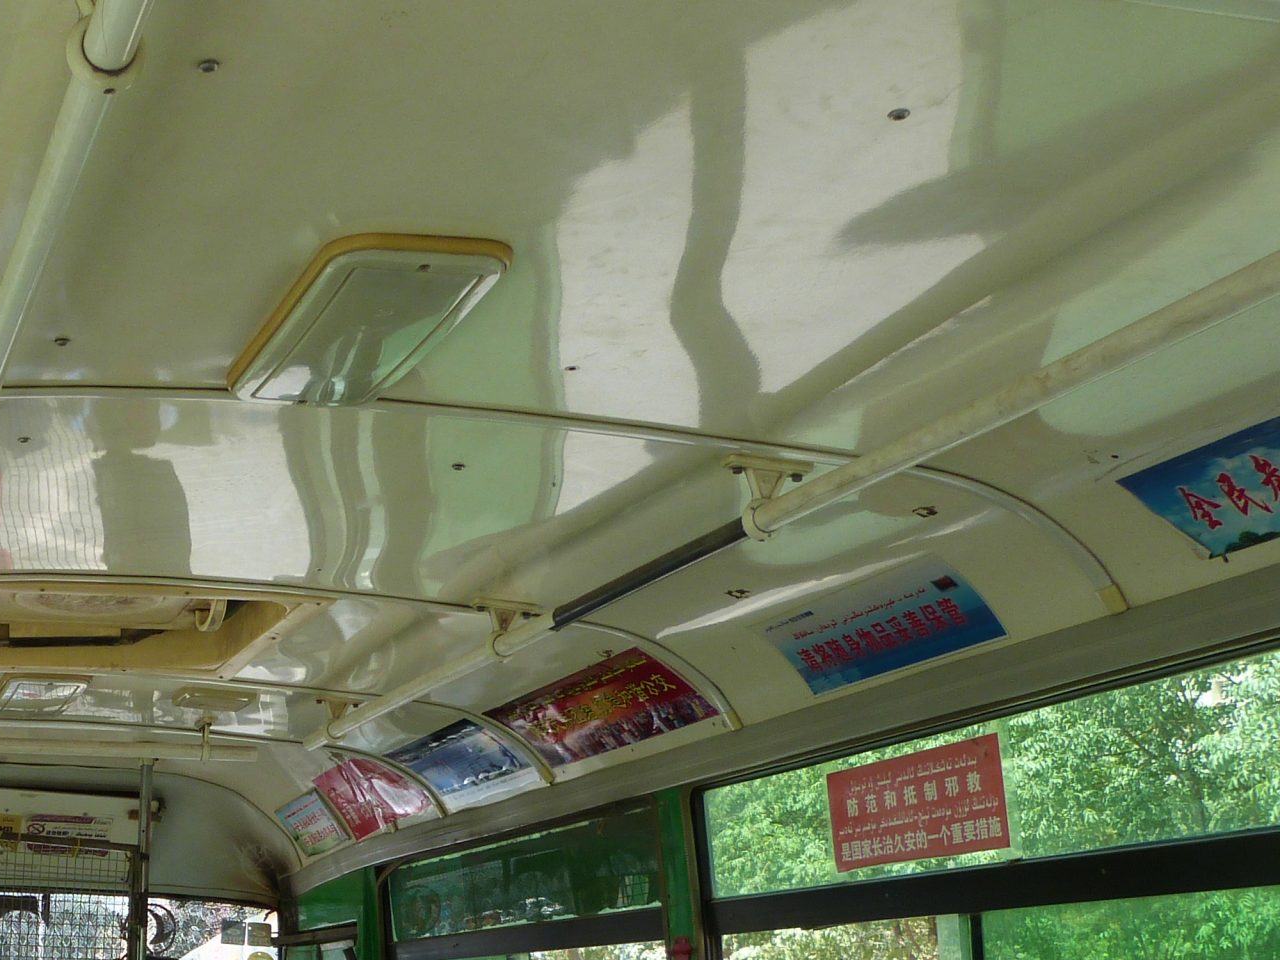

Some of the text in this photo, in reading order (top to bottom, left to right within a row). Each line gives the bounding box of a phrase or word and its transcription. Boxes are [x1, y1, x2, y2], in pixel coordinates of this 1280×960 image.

[796, 597, 968, 673] 请将随身物品妥善保管
[847, 771, 982, 817] 防范和抵制邪教
[841, 816, 1003, 862] 是国家长治久安的一个重要措施
